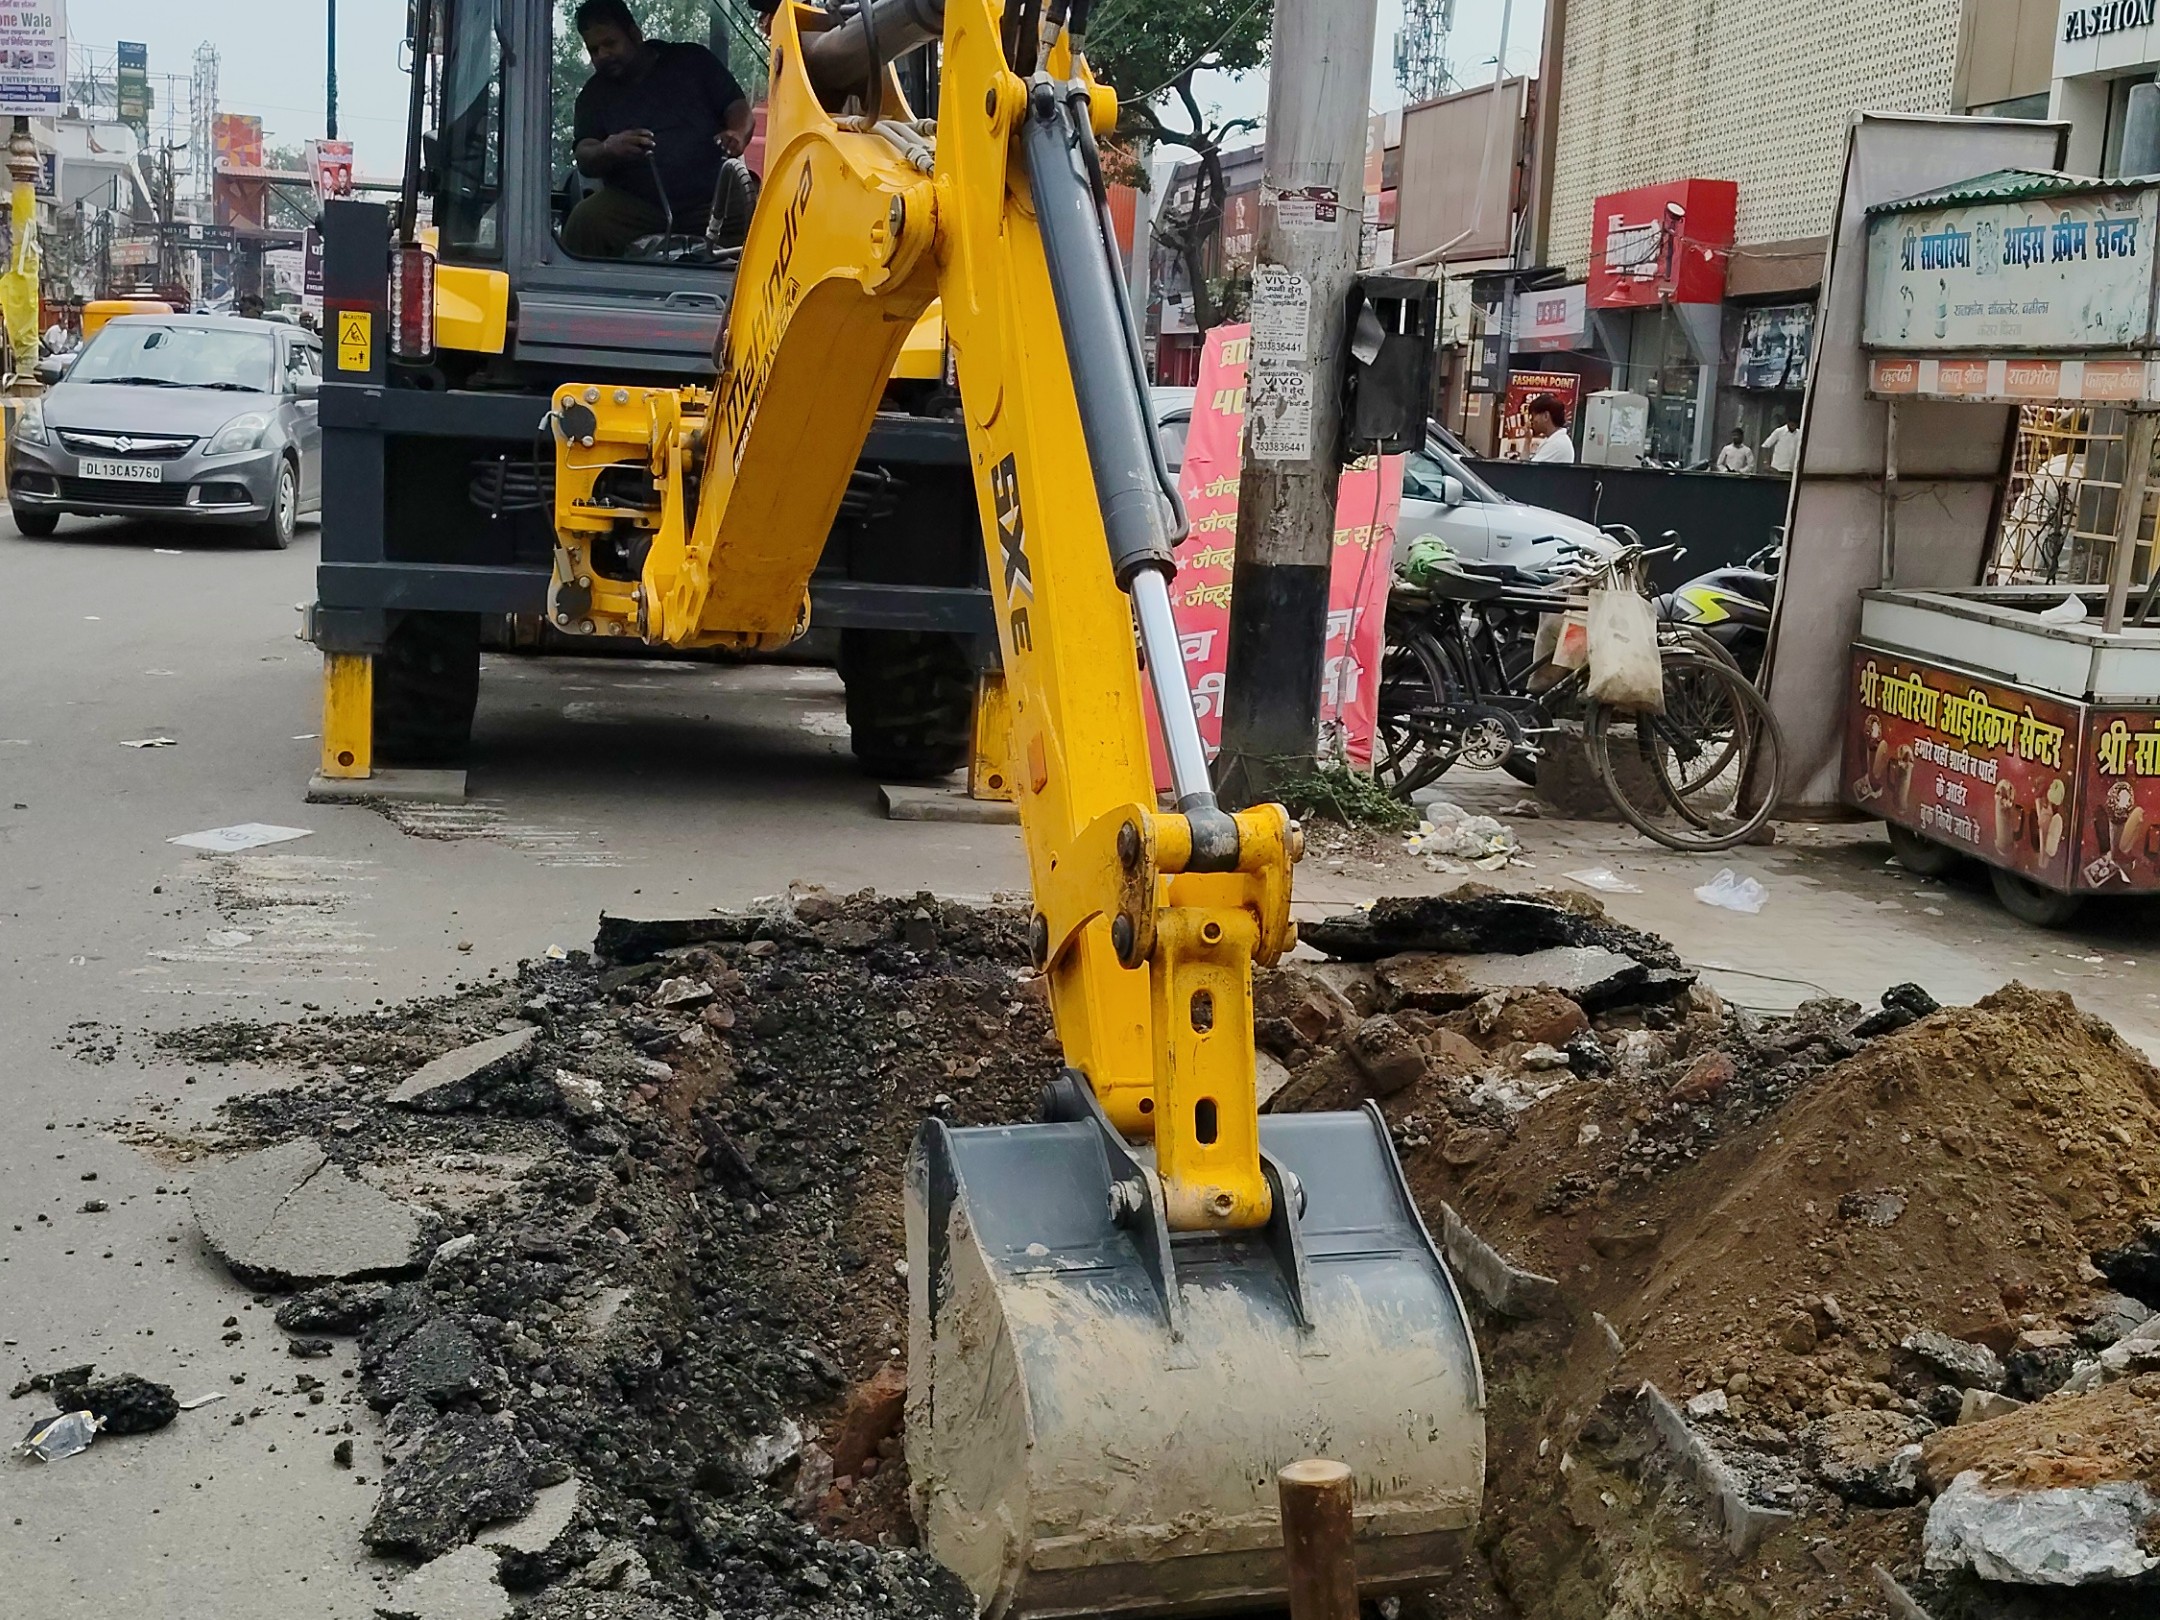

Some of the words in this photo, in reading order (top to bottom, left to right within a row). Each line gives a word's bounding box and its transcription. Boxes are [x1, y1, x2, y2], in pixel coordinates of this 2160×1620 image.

[21, 12, 52, 27] Wala
[2062, 0, 2155, 41] FASHION
[2, 76, 54, 84] ENTERPRISES
[1901, 226, 1917, 271] श्री
[1264, 377, 1304, 387] VIVO
[1512, 375, 1547, 387] FASHION
[1549, 377, 1575, 389] POINT
[1255, 442, 1305, 452] 7533836441
[87, 463, 160, 479] DL13CA5760
[1860, 661, 1880, 708] श्री
[1881, 666, 1940, 728] सांवरिया
[2020, 704, 2064, 770] सेन्टर
[2097, 720, 2132, 775] श्री
[1914, 736, 1934, 761] हमारे
[1949, 748, 1970, 775] शादी
[1978, 758, 1998, 785] पार्टी
[1935, 772, 1946, 797] के
[1920, 802, 1934, 829] बुक
